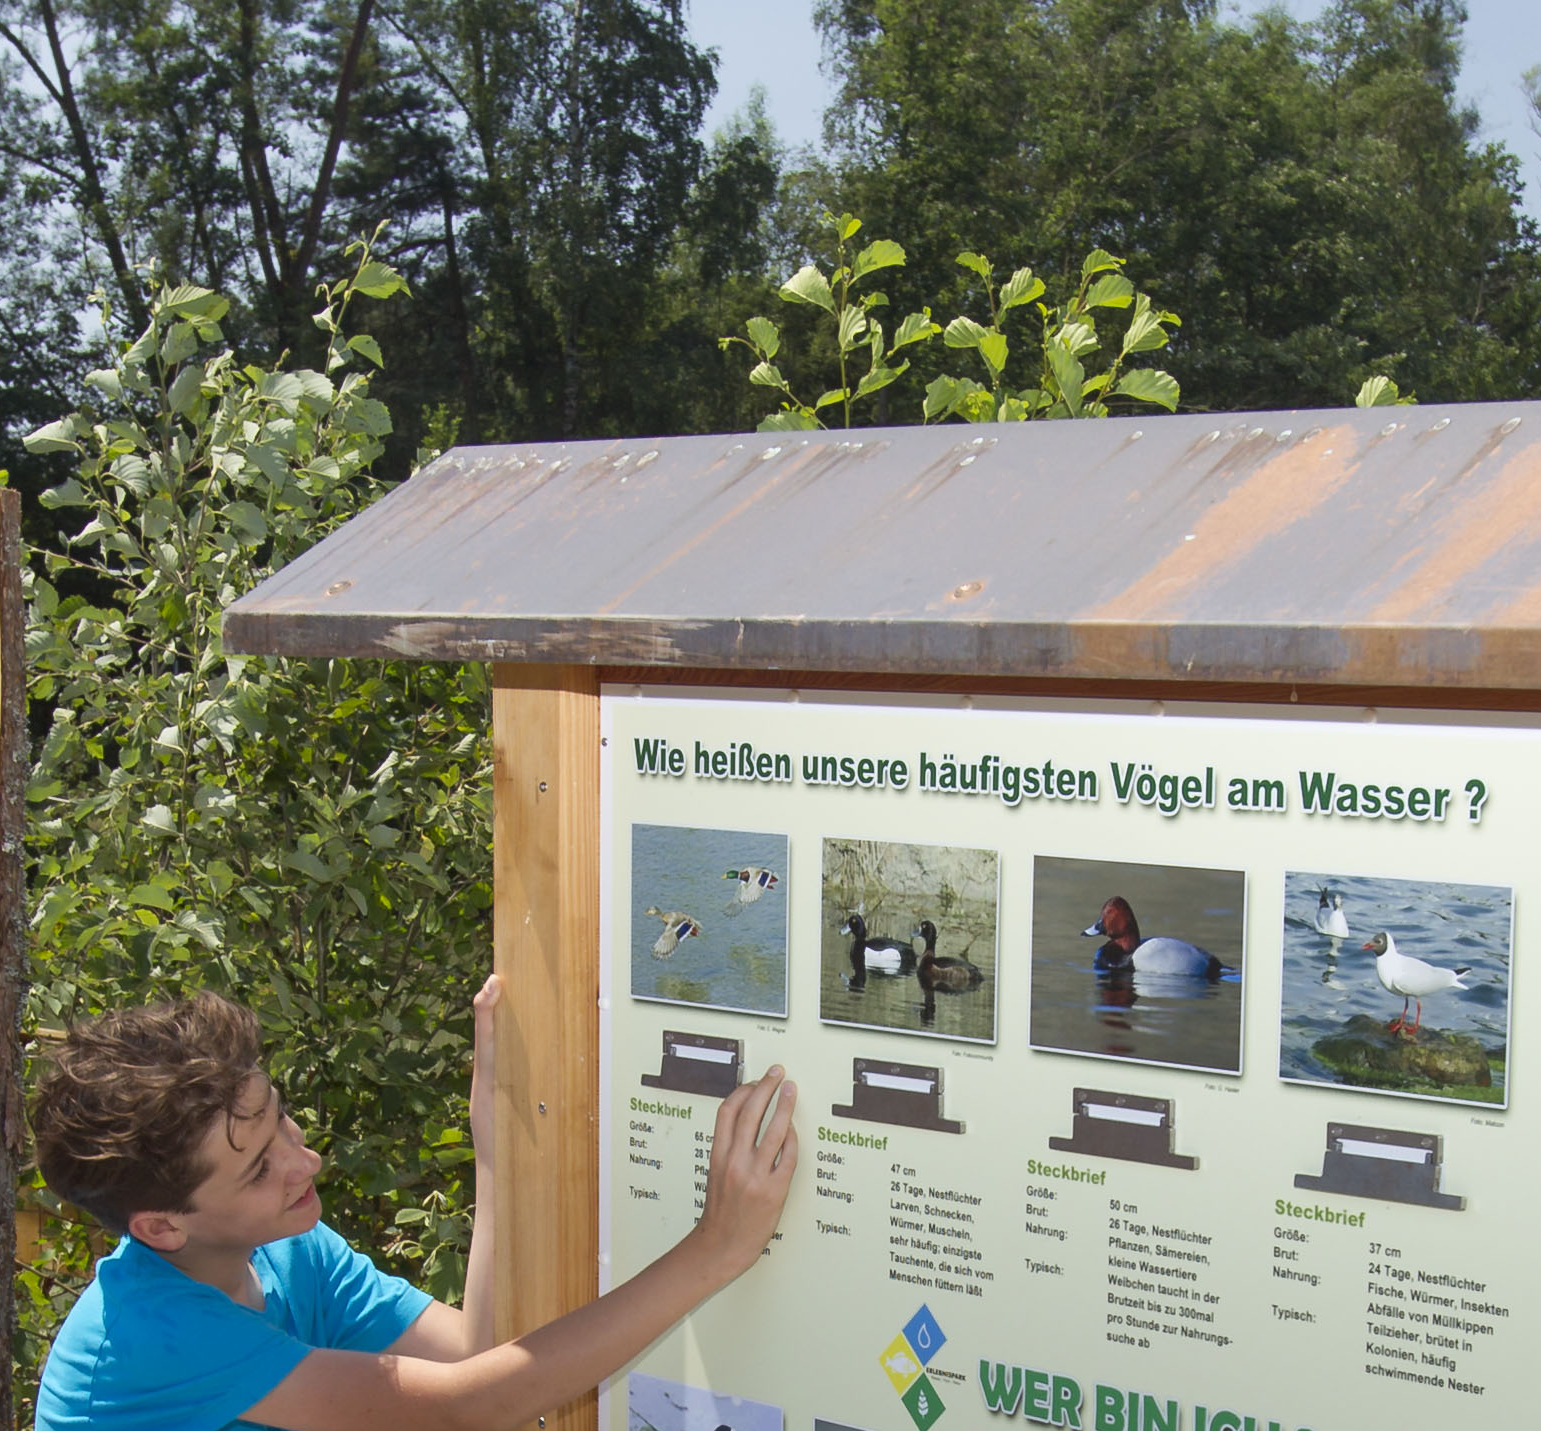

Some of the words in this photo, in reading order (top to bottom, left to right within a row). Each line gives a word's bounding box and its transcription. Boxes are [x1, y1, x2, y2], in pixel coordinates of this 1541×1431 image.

[634, 738, 684, 775] Wie
[694, 742, 792, 781] heißen
[802, 755, 907, 787] unsere
[919, 753, 1097, 802] häufigsten
[1110, 762, 1214, 809] Vögel
[1228, 777, 1285, 808] am
[1299, 771, 1451, 818] Wasser
[1465, 779, 1486, 820] ?
[630, 1098, 692, 1119] Steckbrief
[630, 1121, 654, 1133] Größe:
[818, 1127, 888, 1150] Steckbrief
[630, 1137, 647, 1149] Brut:
[695, 1149, 703, 1158] 28
[630, 1154, 663, 1169] Nahrung:
[1027, 1160, 1106, 1186] Steckbrief
[630, 1186, 660, 1200] Typisch:
[891, 1181, 900, 1191] 26
[903, 1182, 926, 1198] Tage,
[929, 1188, 982, 1206] Nestflüchter
[890, 1199, 921, 1215] Larven,
[924, 1205, 974, 1224] Schnecken,
[1275, 1200, 1365, 1228] Steckbrief
[890, 1217, 925, 1233] Würmer,
[929, 1224, 972, 1242] Muscheln,
[1109, 1218, 1120, 1229] 26
[1123, 1220, 1149, 1236] Tage,
[1152, 1226, 1212, 1246] Nestflüchter
[890, 1235, 908, 1247] sehr
[943, 1245, 982, 1260] einzigste
[1109, 1238, 1152, 1255] Pflanzen,
[1155, 1244, 1210, 1266] Sämereien,
[890, 1252, 936, 1270] Tauchente,
[939, 1261, 951, 1272] die
[955, 1264, 972, 1277] sich
[975, 1270, 994, 1281] vom
[1108, 1256, 1136, 1272] kleine
[1139, 1262, 1198, 1282] Wassertiere
[1368, 1263, 1381, 1275] 24
[1384, 1265, 1414, 1282] Tage,
[1418, 1272, 1486, 1294] Nestflüchter
[890, 1269, 932, 1287] Menschen
[935, 1278, 963, 1293] füttern
[966, 1283, 982, 1297] läßt
[1108, 1275, 1155, 1294] Weibchen
[1158, 1283, 1188, 1299] taucht
[1192, 1289, 1200, 1300] in
[1204, 1290, 1220, 1305] der
[1368, 1283, 1407, 1301] Fische,
[1410, 1290, 1458, 1310] Würmer,
[1461, 1299, 1509, 1318] Insekten
[1367, 1303, 1405, 1320] Abfälle
[1409, 1312, 1429, 1325] von
[1433, 1314, 1494, 1336] Müllkippen
[1367, 1323, 1423, 1344] Teilzieher,
[1426, 1333, 1459, 1350] brütet
[1462, 1342, 1473, 1353] in
[1366, 1342, 1418, 1364] Kolonien,
[1421, 1351, 1456, 1372] häufig
[1365, 1363, 1444, 1388] schwimmende
[1448, 1376, 1485, 1396] Nester
[978, 1360, 1083, 1430] WER
